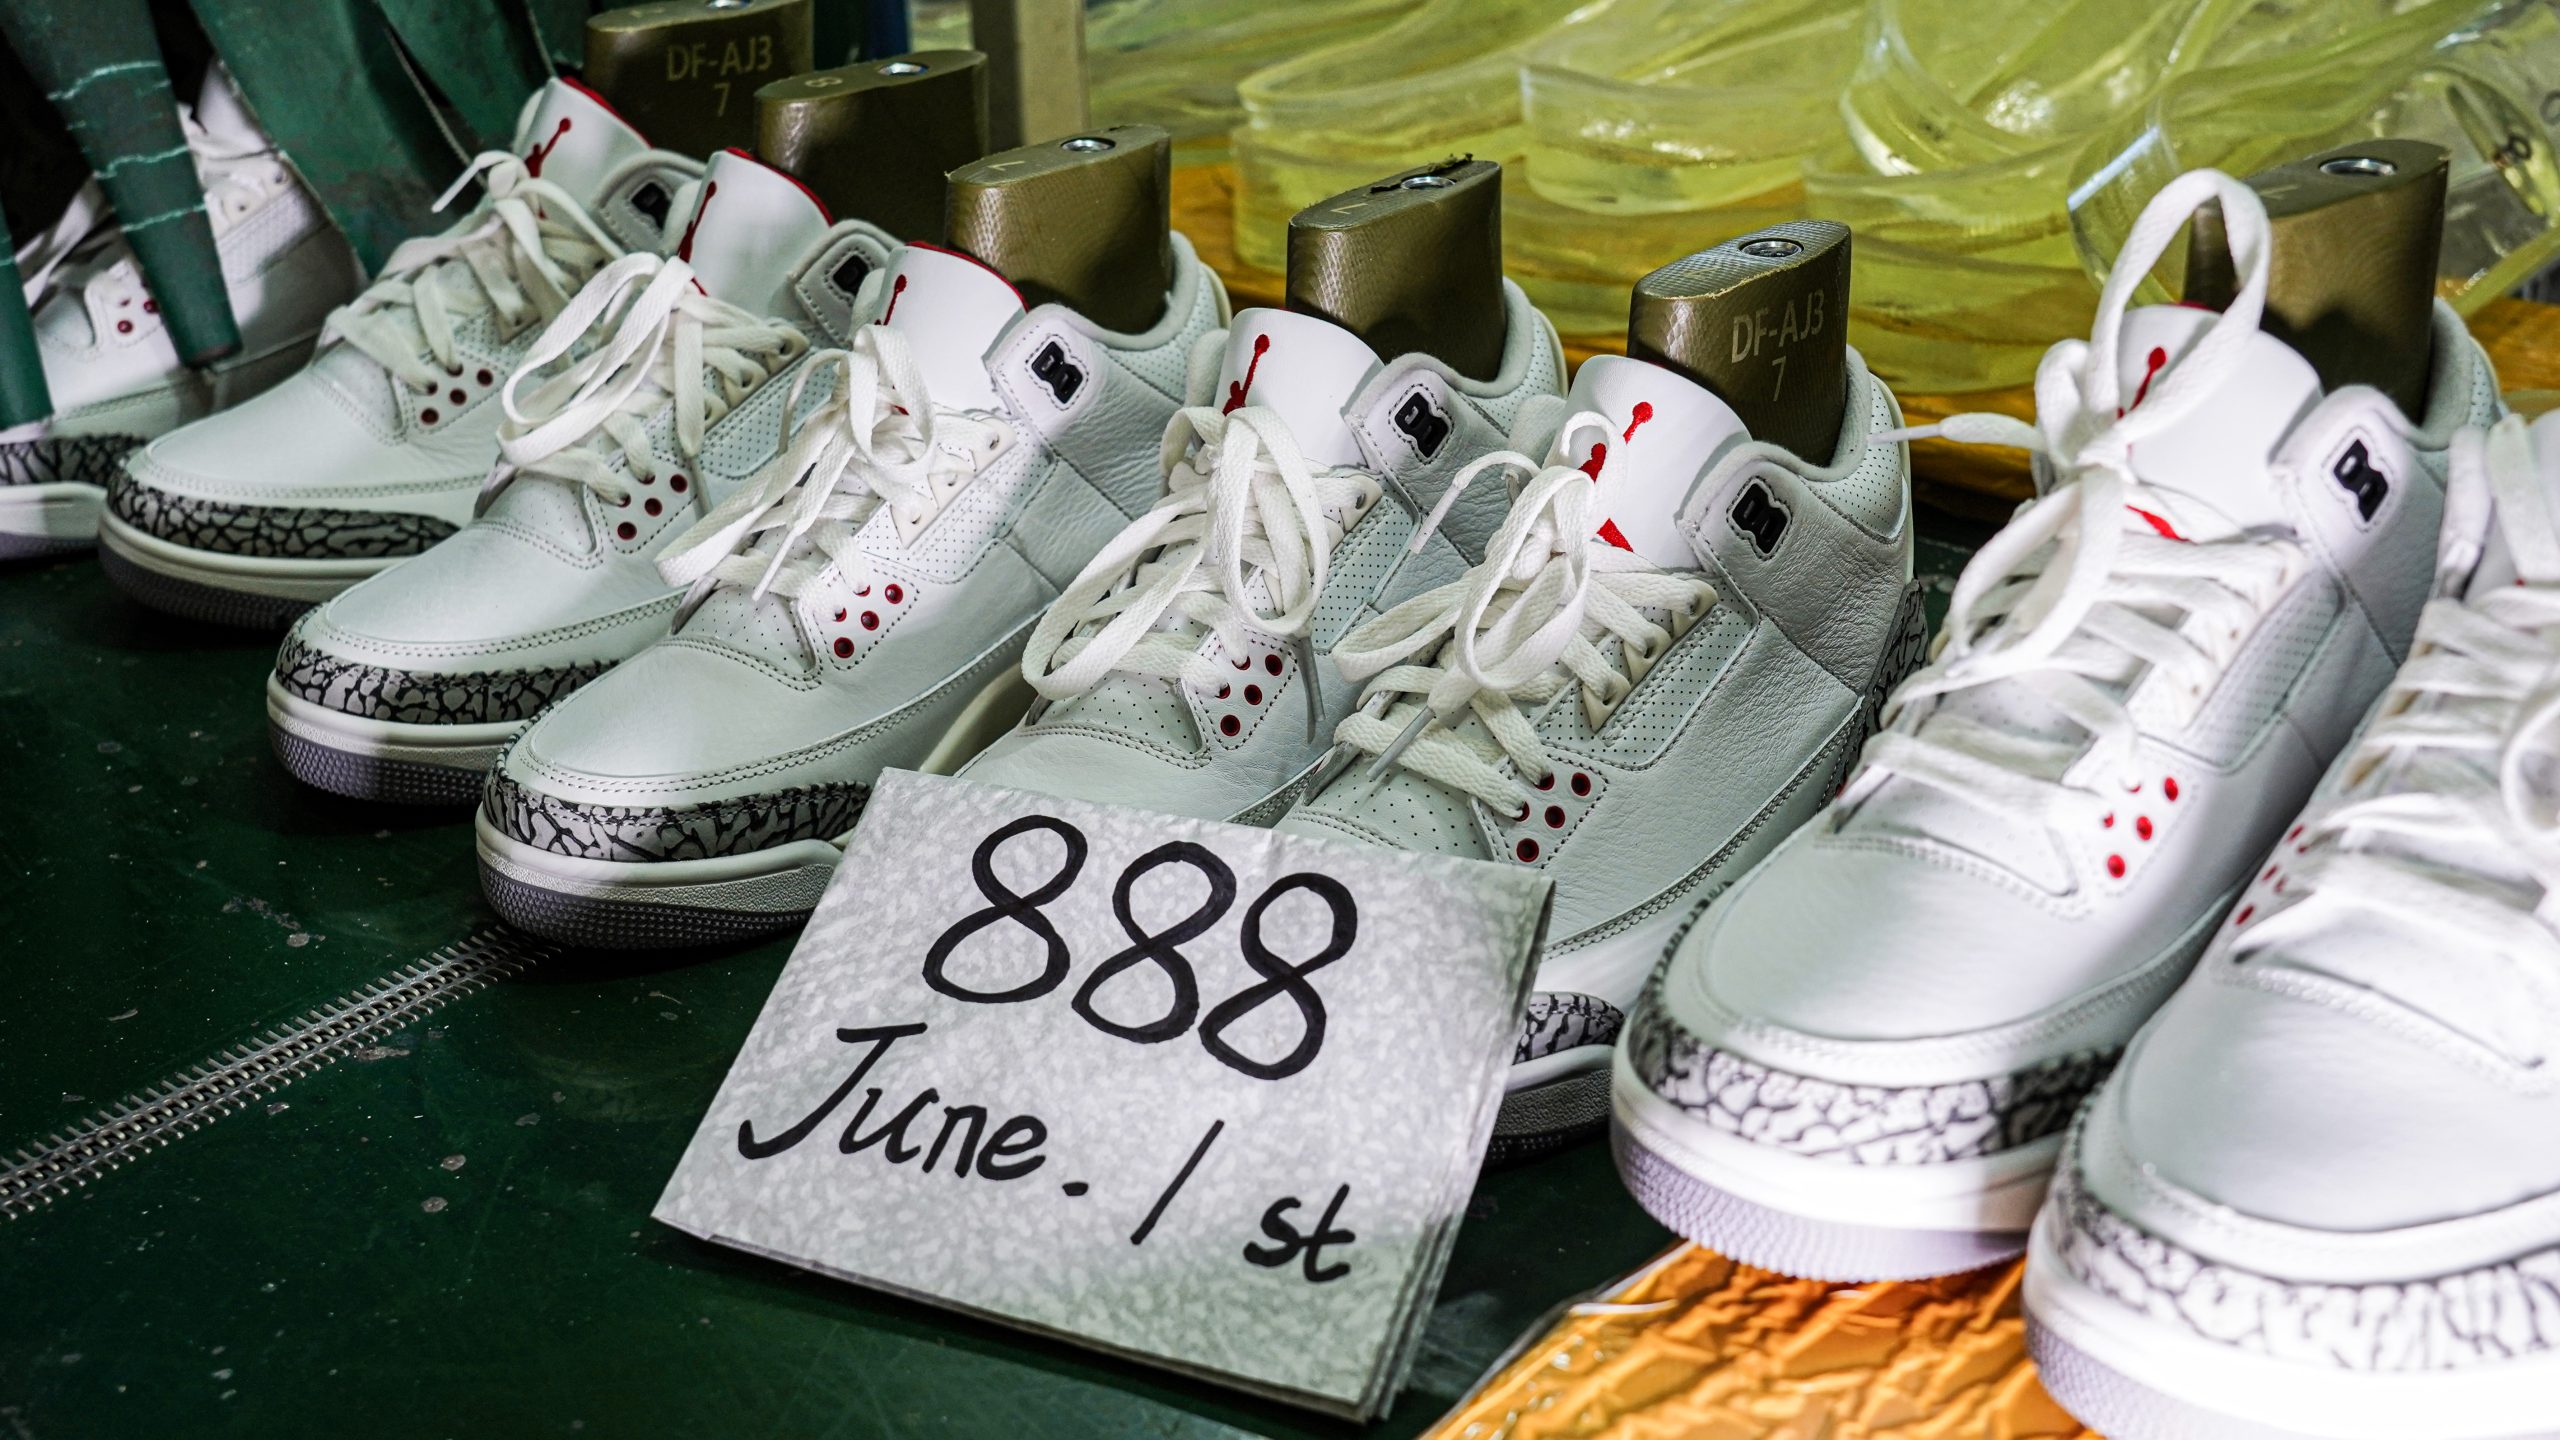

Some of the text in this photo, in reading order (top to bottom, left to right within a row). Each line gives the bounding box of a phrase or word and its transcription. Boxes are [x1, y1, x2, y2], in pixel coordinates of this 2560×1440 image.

[666, 35, 773, 82] DF-AJ3
[714, 82, 731, 118] 7
[1731, 289, 1824, 364] DF-AJ3
[1771, 356, 1787, 402] 7
[922, 815, 1358, 1080] 888
